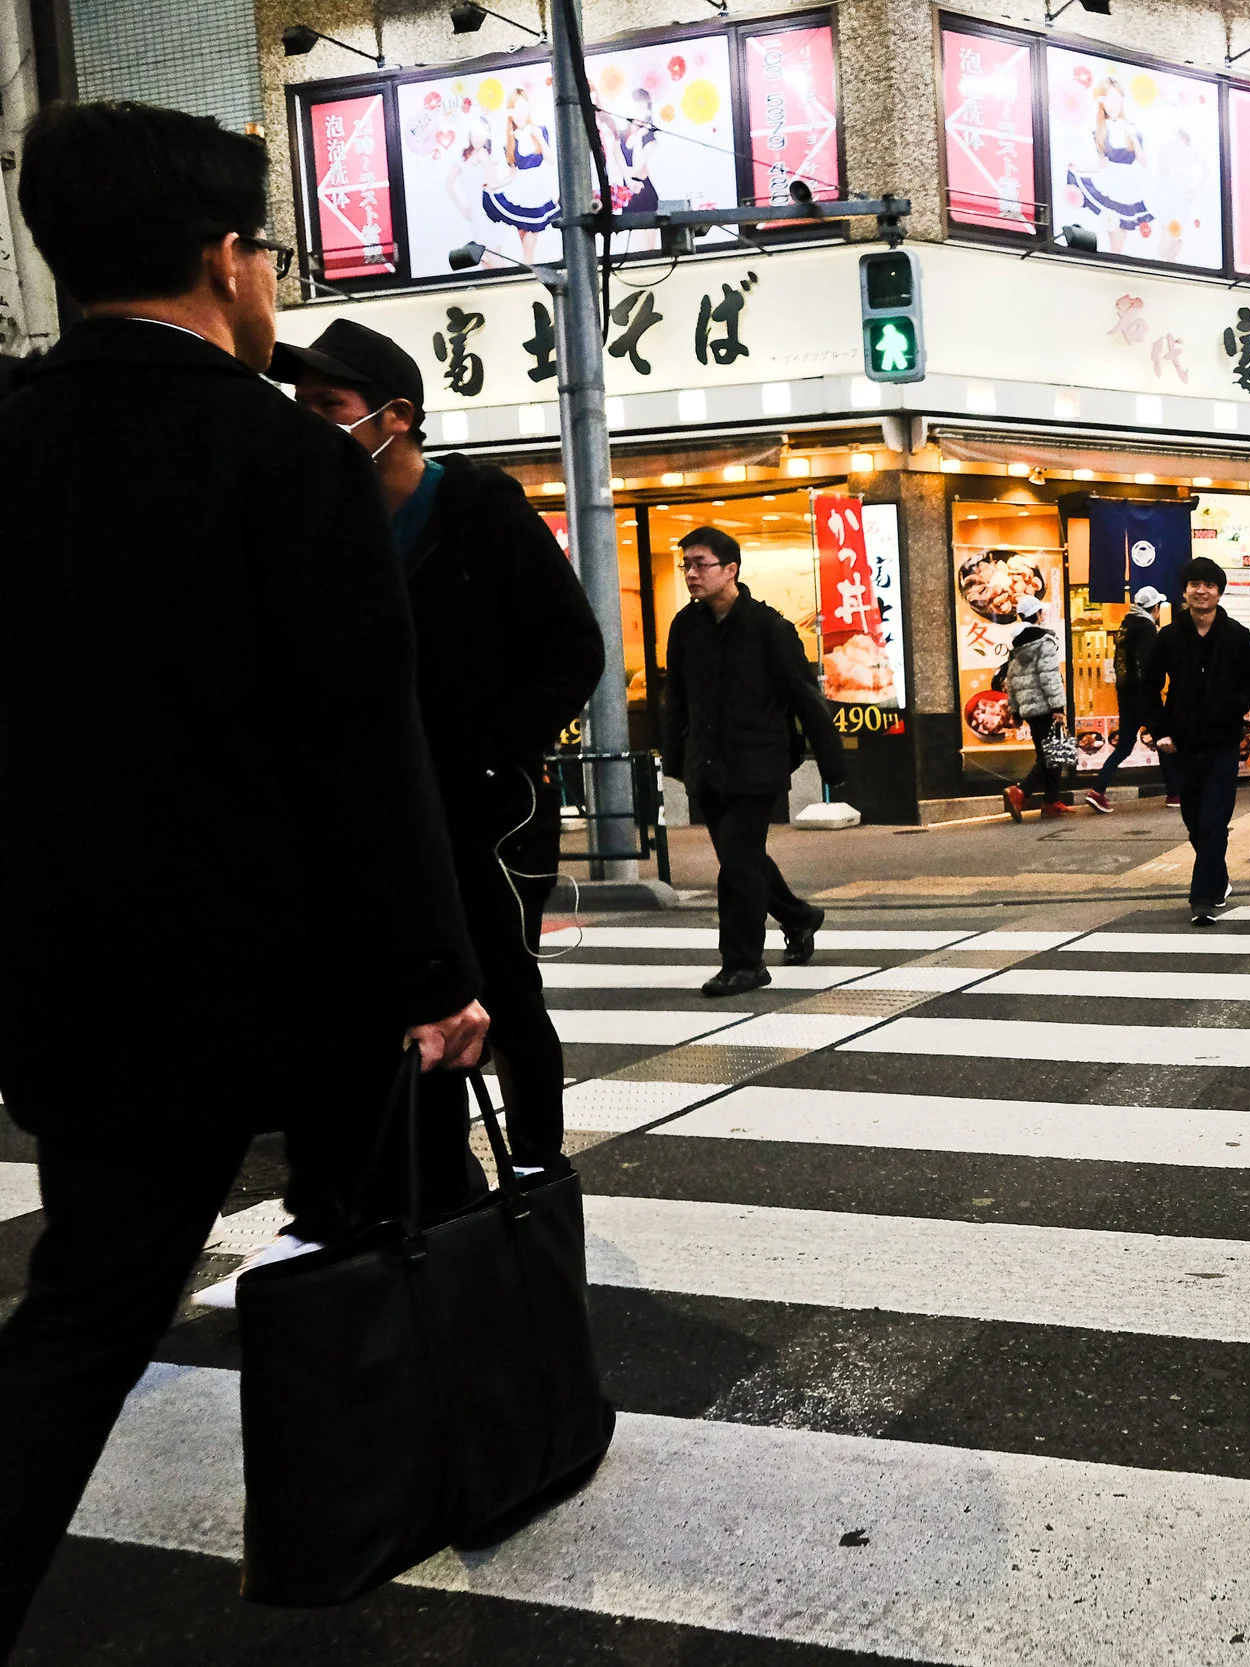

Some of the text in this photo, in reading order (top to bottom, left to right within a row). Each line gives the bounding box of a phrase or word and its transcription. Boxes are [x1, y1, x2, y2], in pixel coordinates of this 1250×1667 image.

[433, 271, 759, 397] 富士そば
[827, 508, 871, 634] かつ丼
[833, 704, 900, 734] 490円
